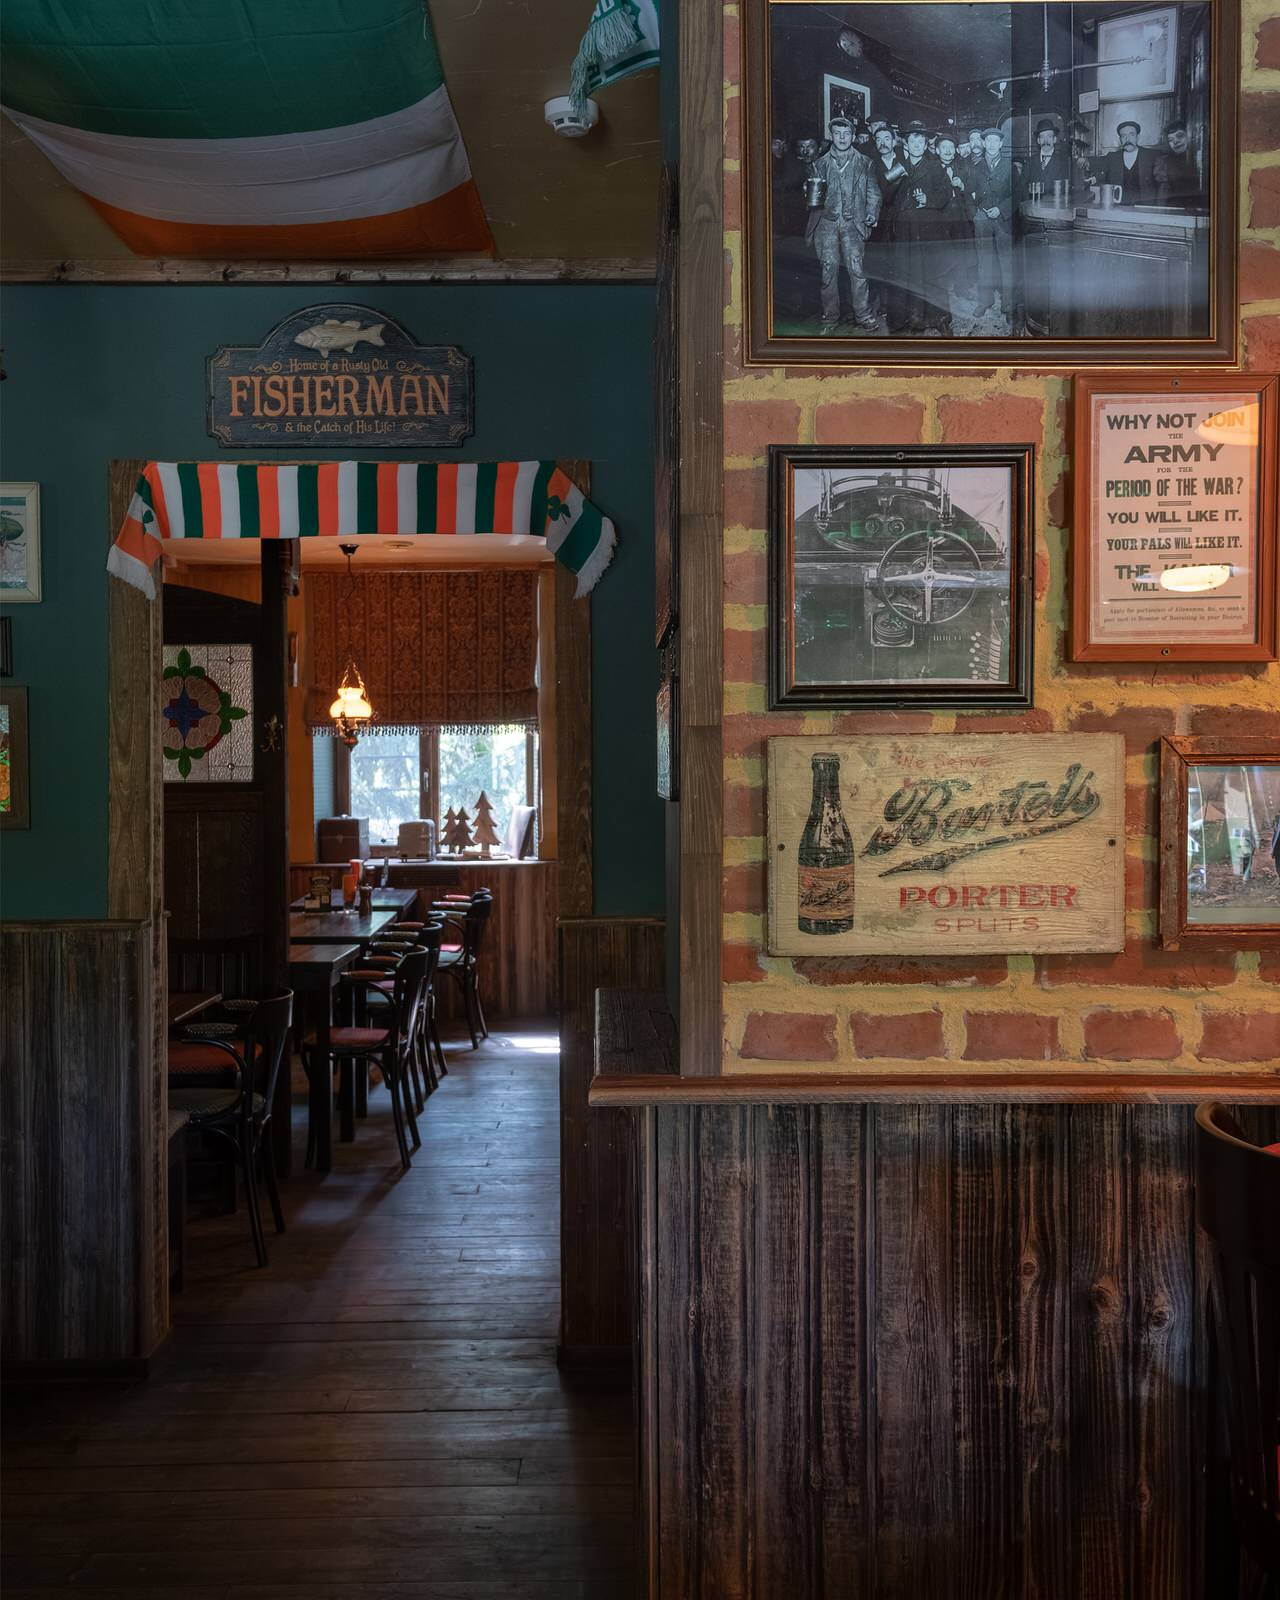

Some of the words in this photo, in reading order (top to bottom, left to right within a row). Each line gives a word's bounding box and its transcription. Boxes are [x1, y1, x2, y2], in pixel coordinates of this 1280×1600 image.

[289, 358, 317, 373] Home
[321, 359, 329, 373] of
[332, 363, 338, 371] a
[341, 358, 370, 373] Rusty
[371, 358, 389, 370] Old
[228, 374, 449, 417] FISHERMAN
[285, 422, 295, 433] &
[296, 421, 312, 432] the
[314, 420, 341, 433] Catch
[344, 421, 353, 434] of
[355, 420, 372, 434] His
[1106, 413, 1152, 430] WHY
[1156, 413, 1197, 429] NOT
[1202, 412, 1245, 428] JOIN
[1124, 443, 1224, 464] ARMY
[1105, 479, 1151, 498] PERIOD
[1156, 478, 1171, 497] OF
[1176, 478, 1197, 496] THE
[1203, 476, 1244, 496] WAR?
[1107, 512, 1139, 524] YOU
[1145, 511, 1182, 523] WILL
[1187, 510, 1219, 522] LIKE
[1224, 509, 1242, 522] IT.
[1106, 538, 1137, 551] YOUR
[1140, 537, 1171, 550] PALS
[1174, 537, 1193, 549] WILL
[1195, 536, 1225, 549] LIKE
[1226, 536, 1243, 548] IT.
[1114, 564, 1151, 580] THE
[1131, 582, 1159, 592] WILL
[899, 884, 1079, 910] PORTER
[934, 917, 1041, 933] SPLITS
